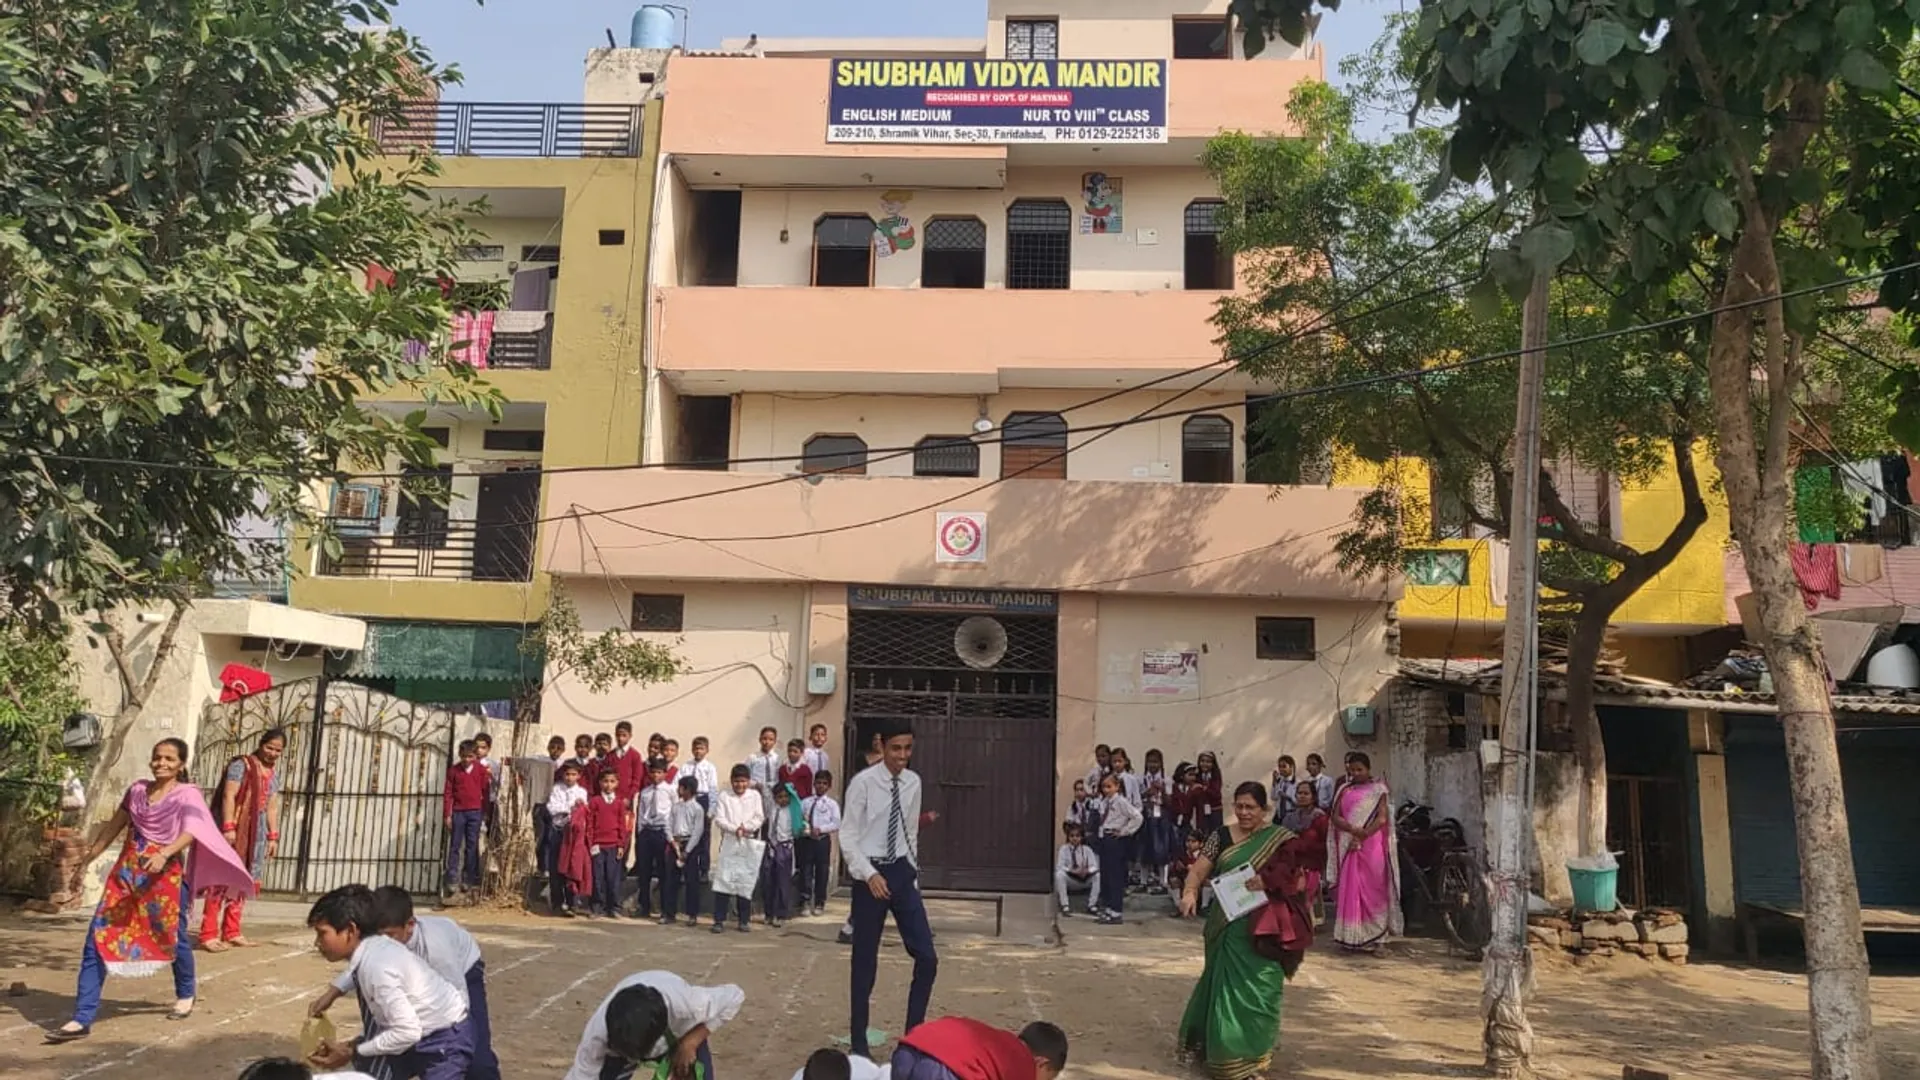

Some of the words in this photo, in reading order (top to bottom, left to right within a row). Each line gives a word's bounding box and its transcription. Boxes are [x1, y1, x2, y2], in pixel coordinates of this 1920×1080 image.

[837, 60, 966, 87] SHUBHAM
[973, 61, 1050, 87] VIDYA
[1057, 61, 1161, 88] MANDIR
[979, 93, 990, 102] BY
[1018, 94, 1028, 102] OF
[1030, 93, 1069, 103] HARYANA
[842, 109, 897, 121] ENGLISH
[901, 109, 951, 121] MEDIUM
[1023, 109, 1051, 122] NUR
[1053, 109, 1070, 122] TO
[1108, 109, 1150, 122] CLASS
[834, 127, 876, 140] 209-210,
[879, 127, 919, 138] Shramik
[922, 128, 951, 140] Vihar,
[994, 129, 1046, 140] Faridabad,
[1055, 128, 1076, 139] PH:
[1078, 128, 1160, 140] 0129-2252136
[939, 590, 985, 603] VIDYA
[990, 592, 1053, 607] MANDIR
